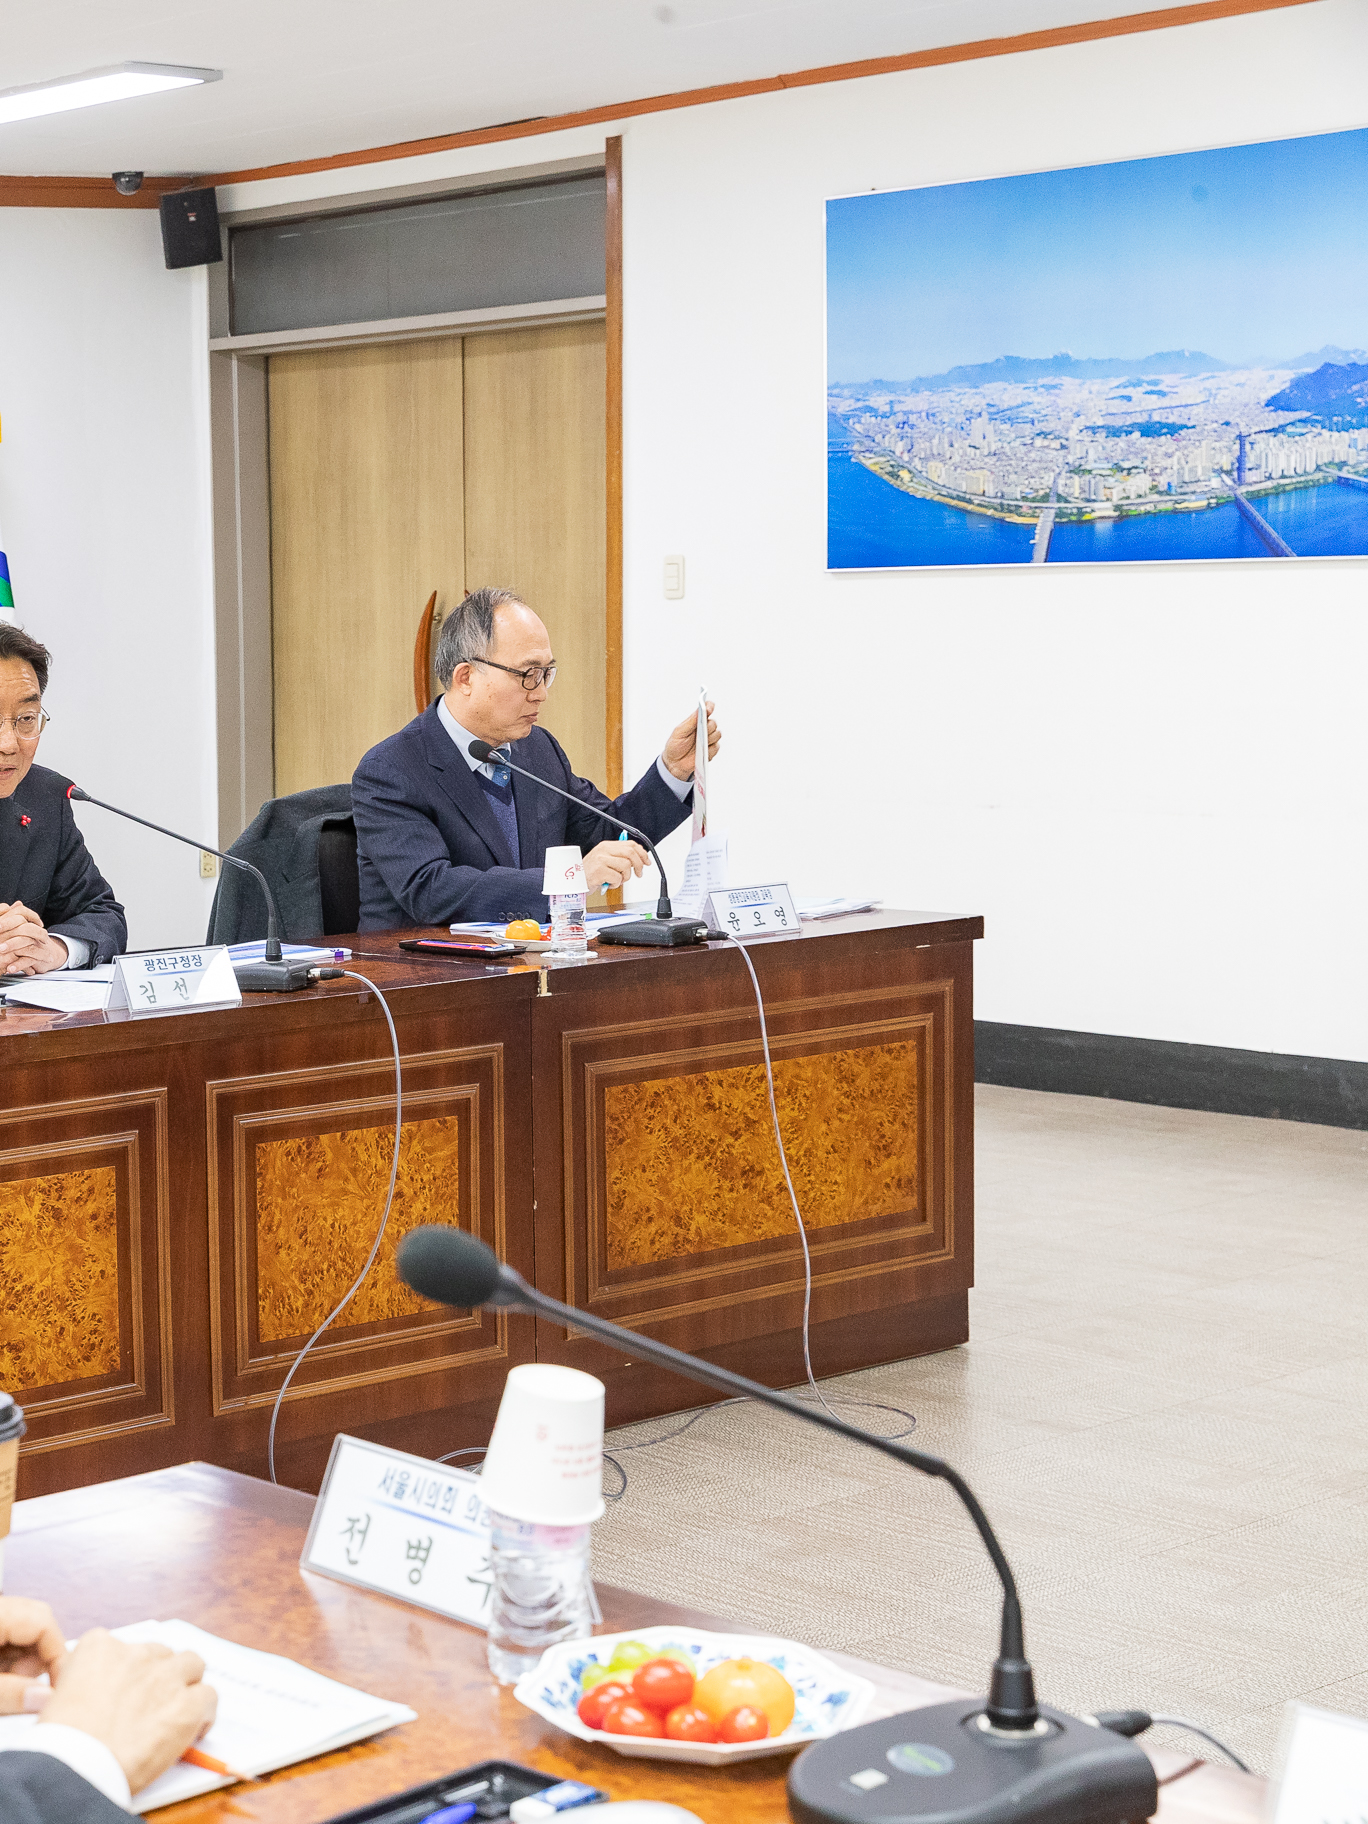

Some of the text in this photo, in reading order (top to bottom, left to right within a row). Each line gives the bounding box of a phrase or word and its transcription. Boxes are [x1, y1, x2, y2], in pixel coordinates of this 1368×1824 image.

[143, 954, 203, 972] 광진구청장
[139, 981, 157, 1004] 김
[377, 1466, 460, 1515] 서울시의회
